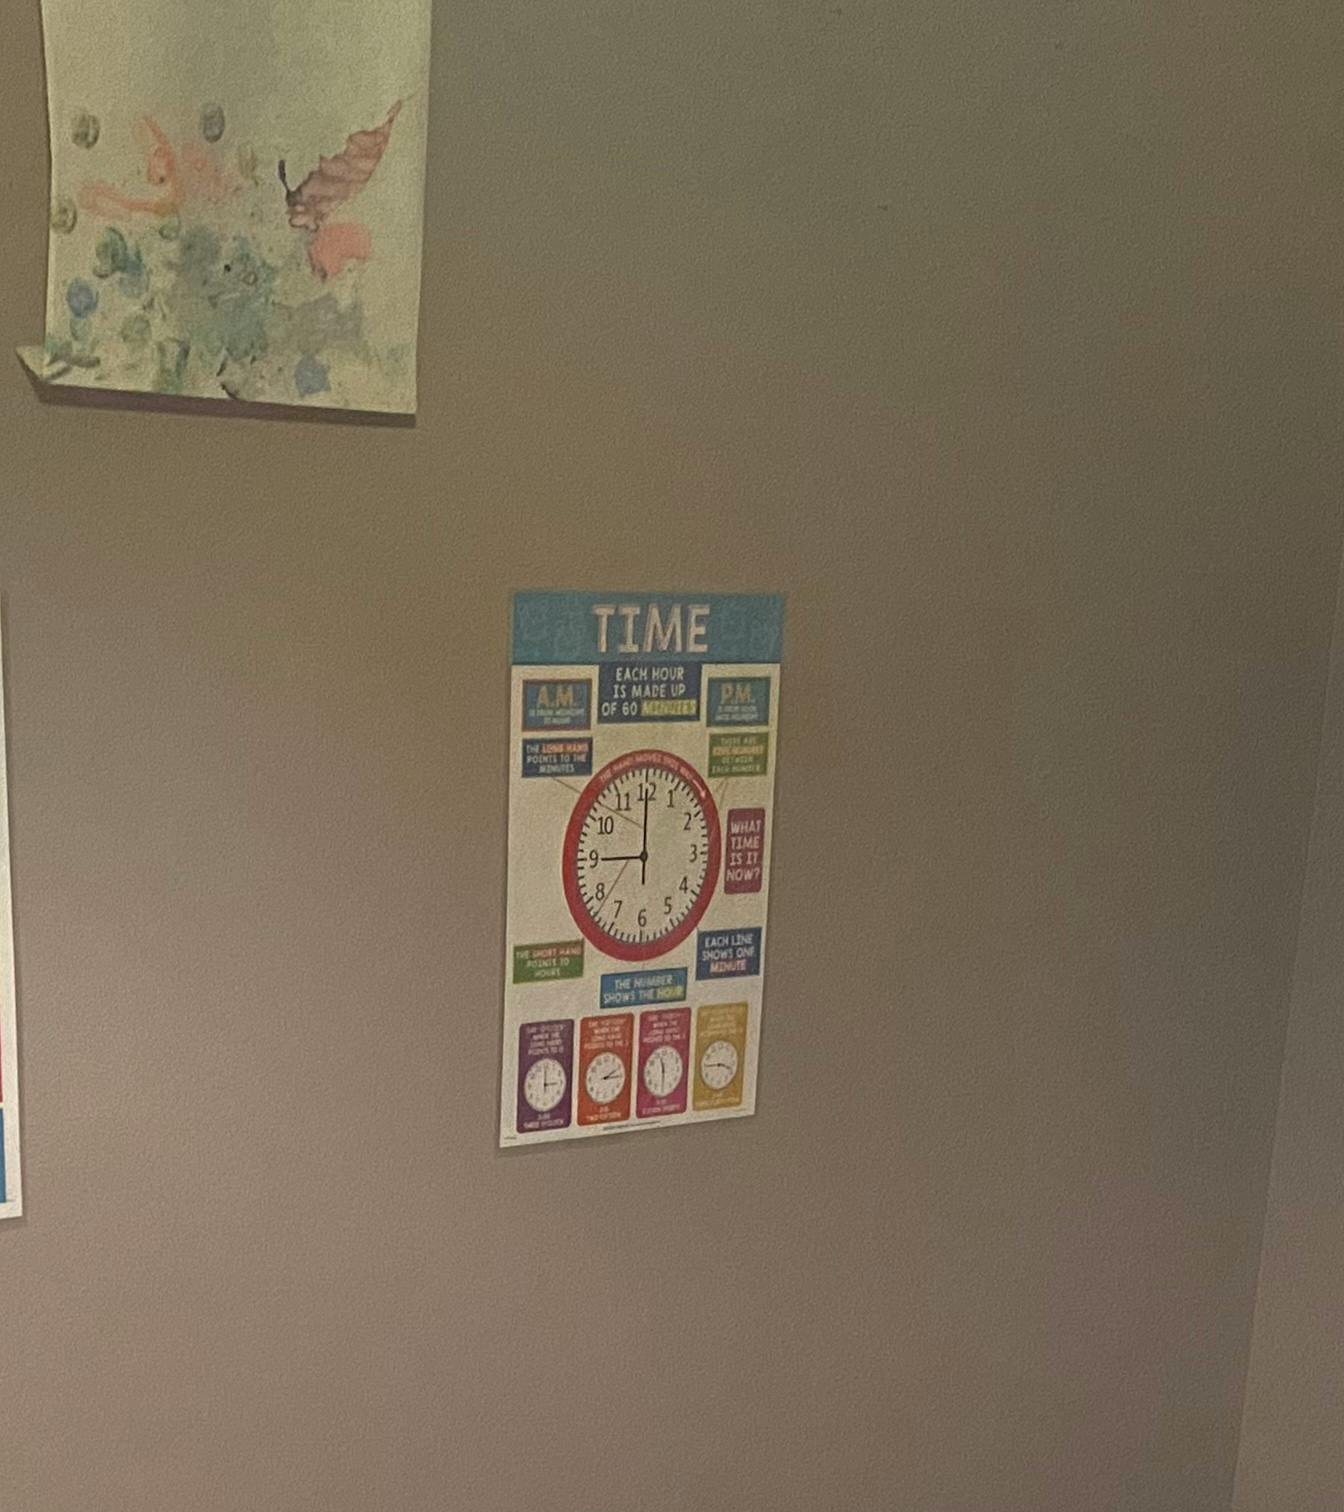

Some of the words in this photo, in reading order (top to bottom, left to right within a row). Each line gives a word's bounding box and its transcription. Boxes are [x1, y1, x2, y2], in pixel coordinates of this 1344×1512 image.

[592, 603, 711, 653] TIME
[616, 667, 648, 682] EACH
[651, 666, 685, 681] HOUR
[613, 684, 627, 699] IS
[631, 684, 666, 699] MADE
[671, 682, 686, 697] UP
[601, 702, 617, 717] OF
[622, 701, 638, 716] 60
[637, 783, 657, 802] 12
[667, 789, 674, 808] 1
[616, 792, 632, 811] 11
[597, 817, 614, 835] 10
[683, 812, 692, 831] 2
[730, 820, 761, 834] WHAT
[730, 836, 760, 851] TIME
[589, 850, 599, 868] 9
[690, 845, 698, 863] 3
[729, 852, 743, 866] IS
[746, 852, 759, 865] IT
[726, 867, 760, 881] NOW?
[595, 883, 605, 900] 8
[679, 877, 688, 894] 4
[613, 901, 623, 918] 7
[664, 897, 672, 915] 5
[637, 909, 647, 927] 6
[704, 935, 729, 948] EACH
[731, 933, 753, 946] LINE
[702, 947, 733, 961] SHOWS
[736, 946, 755, 958] ONE
[709, 959, 746, 973] MINUTE
[615, 978, 631, 990] THE
